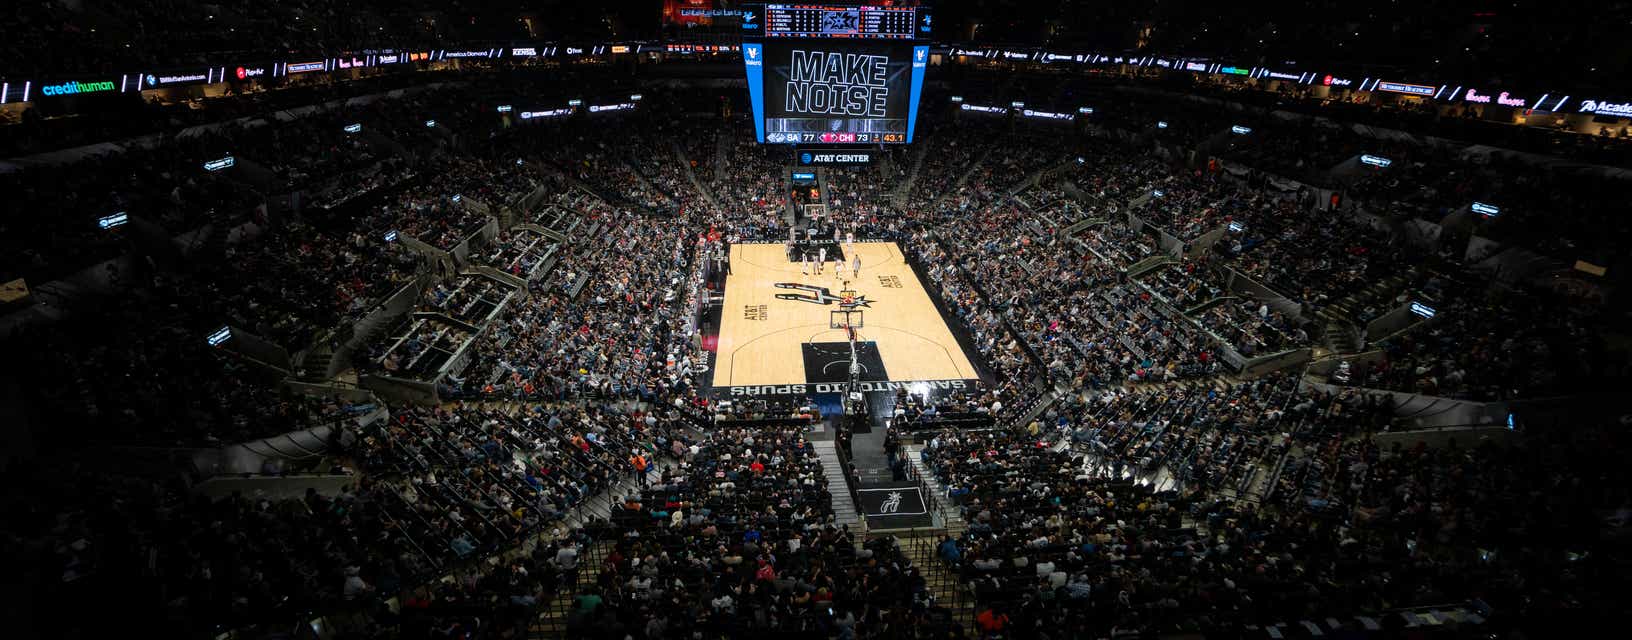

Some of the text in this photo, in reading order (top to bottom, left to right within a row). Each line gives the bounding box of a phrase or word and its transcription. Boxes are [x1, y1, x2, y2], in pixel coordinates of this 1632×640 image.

[791, 50, 888, 87] MAKE
[42, 81, 115, 96] credithuman
[785, 82, 888, 117] NOISE
[787, 134, 904, 142] SA 77 CHI 73 43.1
[813, 154, 870, 162] AT&T CENTER
[730, 384, 807, 396] SPURS
